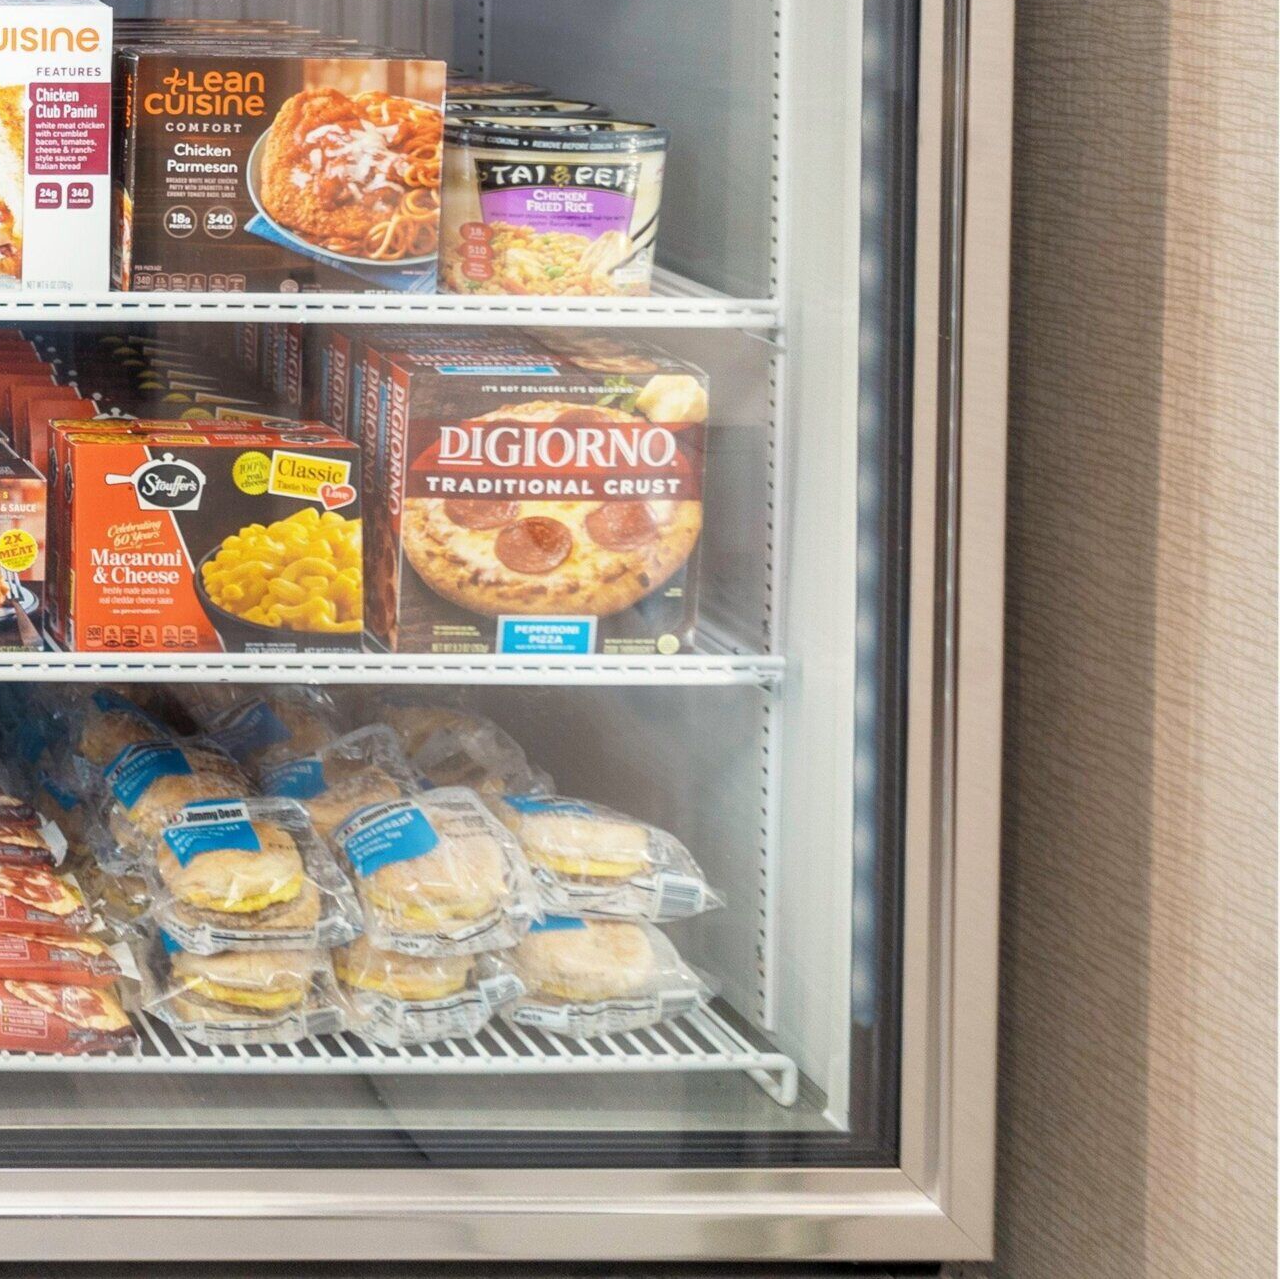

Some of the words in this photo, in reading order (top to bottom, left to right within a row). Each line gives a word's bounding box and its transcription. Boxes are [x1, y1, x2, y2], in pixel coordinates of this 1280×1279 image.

[37, 67, 102, 77] FEATURES
[186, 71, 265, 92] Lean
[36, 88, 79, 102] Chicken
[36, 104, 61, 118] Club
[63, 104, 97, 118] Panini
[166, 123, 242, 133] COMFORT
[174, 144, 231, 157] Chicken
[167, 160, 238, 174] Parmesan
[491, 165, 546, 184] TAI
[575, 167, 625, 187] PEI
[40, 189, 57, 200] 24g
[71, 189, 89, 198] 340
[533, 190, 587, 201] CHICKEN
[526, 201, 562, 212] FRIED
[565, 202, 593, 213] RICE
[207, 214, 233, 225] 340
[278, 459, 342, 483] Classic
[142, 473, 197, 497] Stouffer's
[427, 476, 594, 494] TRADITIONAL
[604, 477, 681, 494] CRUST
[325, 488, 349, 499] Love
[9, 503, 37, 512] SAUCE
[3, 534, 23, 544] 2X
[0, 547, 34, 558] MEAT
[91, 549, 182, 567] Macaroni
[92, 568, 109, 584] &
[111, 567, 180, 584] Cheese
[514, 625, 580, 635] PEPPERONI
[529, 635, 564, 644] PIZZA
[186, 809, 216, 822] Jimmy
